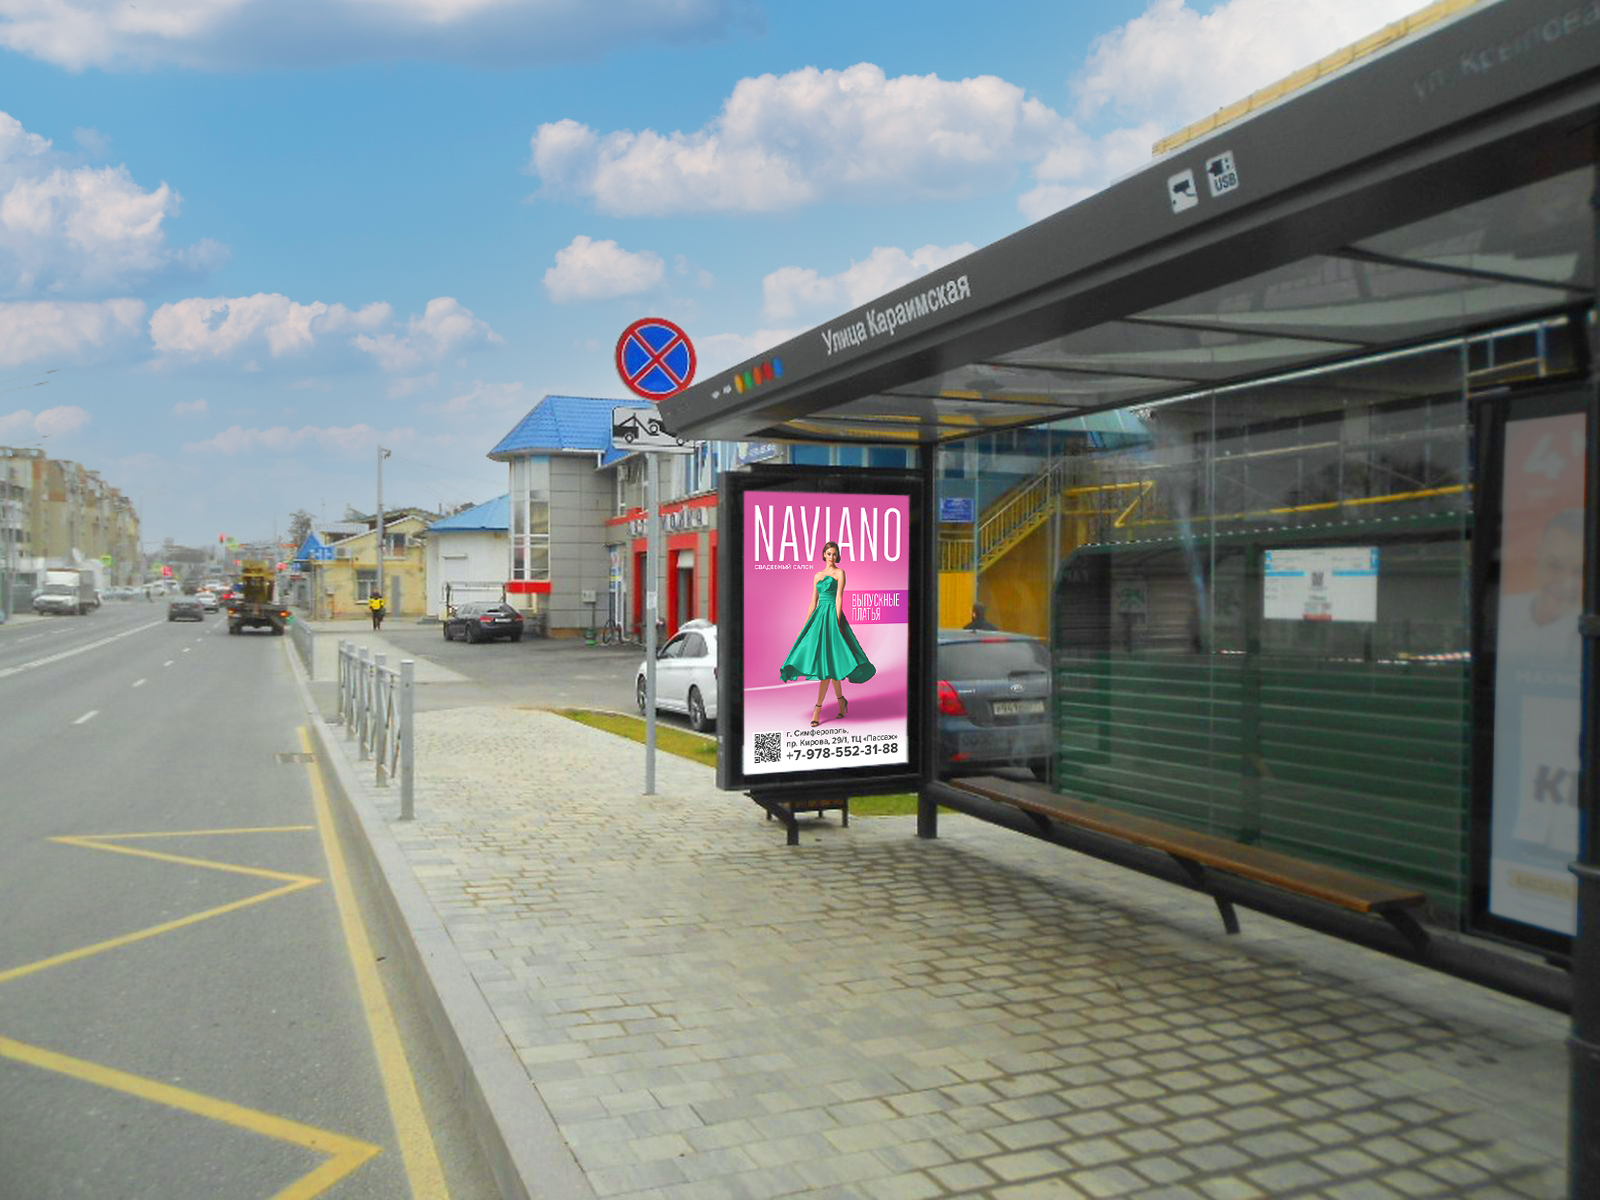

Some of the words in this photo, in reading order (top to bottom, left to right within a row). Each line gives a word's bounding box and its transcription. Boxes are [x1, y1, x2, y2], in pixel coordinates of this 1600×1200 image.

[1215, 172, 1237, 192] USB
[821, 320, 867, 355] Улица
[867, 275, 972, 336] Караимская
[754, 505, 902, 562] NAVIANO
[851, 593, 900, 607] ВЫПУСКНЫЕ
[851, 607, 881, 621] ПЛАТЬЯ
[793, 728, 850, 738] Симферополь,
[786, 740, 798, 748] пр.
[800, 738, 831, 747] Кирова,
[851, 735, 862, 743] ТЦ
[786, 742, 899, 761] +7-978-552-31-88
